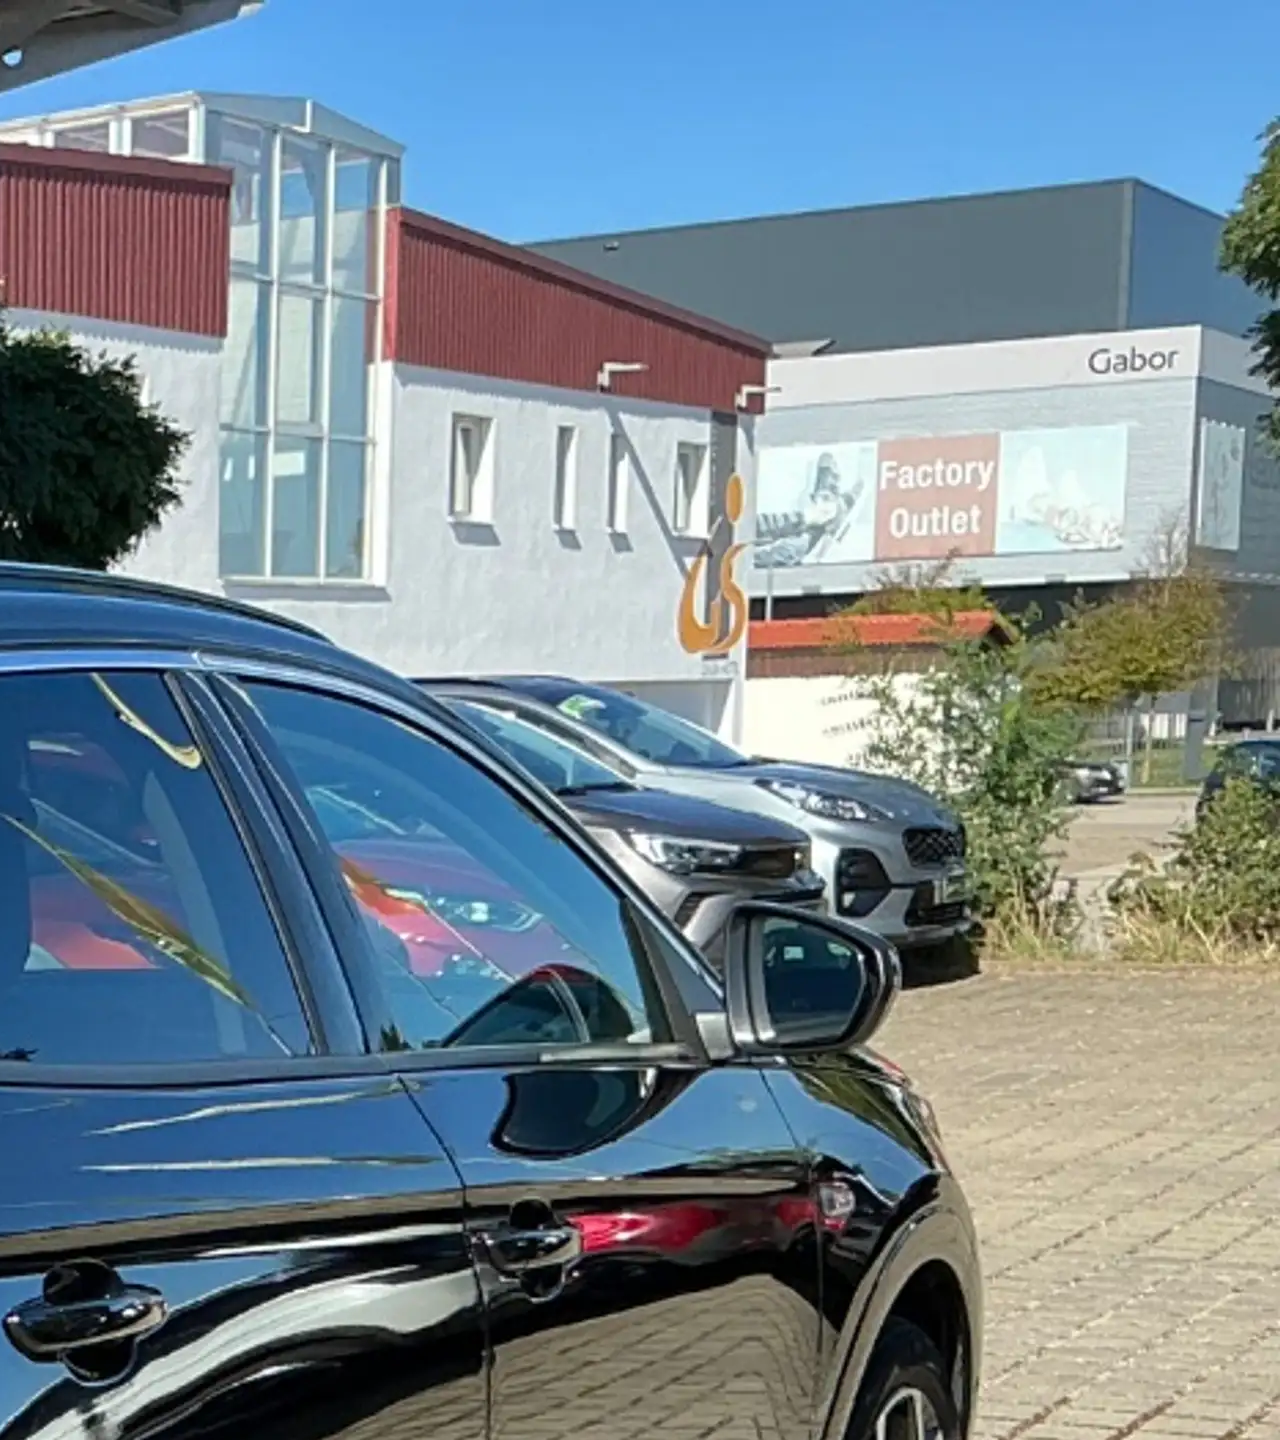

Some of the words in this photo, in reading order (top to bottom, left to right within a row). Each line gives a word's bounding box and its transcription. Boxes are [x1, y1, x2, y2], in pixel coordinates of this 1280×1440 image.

[1087, 345, 1180, 376] Gabor
[879, 457, 995, 491] Factory
[889, 504, 982, 539] Outlet
